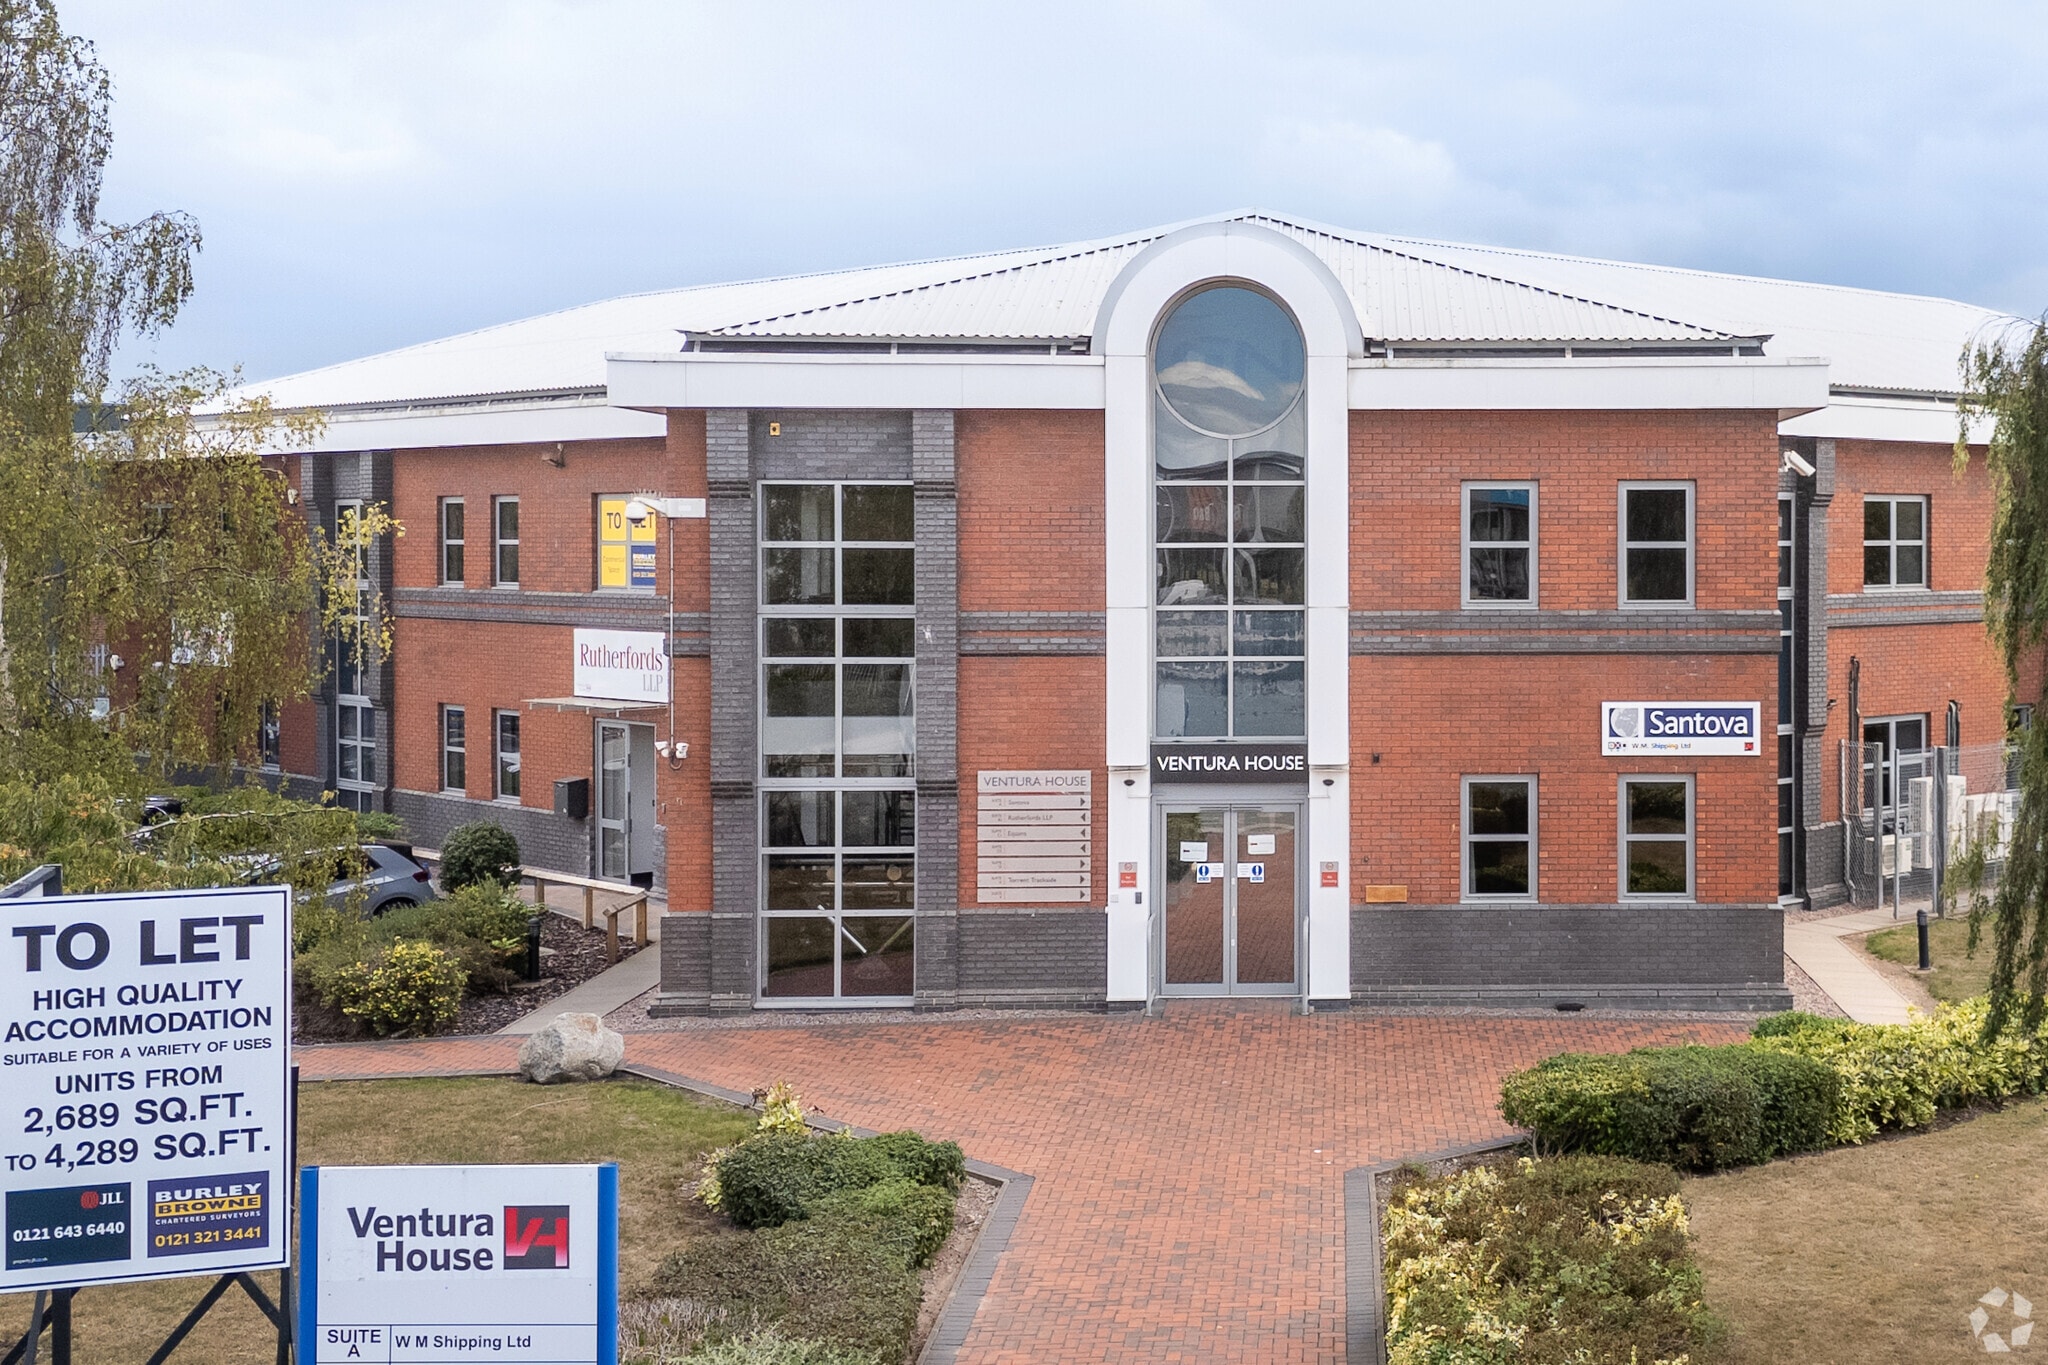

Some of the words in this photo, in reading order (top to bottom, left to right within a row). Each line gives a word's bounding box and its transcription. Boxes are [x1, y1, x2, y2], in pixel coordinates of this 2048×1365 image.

[606, 512, 622, 528] TO
[580, 643, 663, 672] Rutherfords
[643, 674, 664, 692] LLP
[1649, 710, 1748, 735] Santova
[1156, 755, 1241, 771] VENTURA
[1244, 755, 1304, 771] HOUSE
[984, 776, 1042, 787] VENTURA
[1045, 776, 1087, 787] HOUSE
[12, 922, 111, 972] TO
[140, 914, 264, 966] LET
[33, 986, 106, 1011] HIGH
[117, 978, 244, 1006] QUALITY
[4, 1006, 272, 1043] ACCOMMODATION
[3, 1050, 78, 1066] SUITABLE
[82, 1048, 114, 1062] FOR
[120, 1047, 132, 1058] A
[138, 1042, 202, 1058] VARIETY
[206, 1040, 228, 1054] OF
[233, 1038, 272, 1052] USES
[55, 1070, 136, 1095] UNITS
[145, 1064, 223, 1090] FROM
[24, 1102, 120, 1136] 2,689
[134, 1092, 252, 1126] SQ.FT.
[4, 1154, 36, 1172] TO
[44, 1138, 138, 1173] 4,289
[154, 1127, 271, 1161] SQ.FT.
[99, 1191, 125, 1206] JLL
[155, 1182, 262, 1203] BURLEY
[158, 1196, 260, 1215] BROWNE
[155, 1215, 207, 1226] CHARTERED
[210, 1210, 262, 1222] SURVEYORS
[346, 1206, 494, 1238] Ventura
[12, 1228, 50, 1242] 0121
[54, 1224, 82, 1239] 643
[86, 1221, 126, 1237] 6440
[154, 1232, 190, 1248] 0121
[194, 1230, 220, 1244] 321
[224, 1226, 262, 1242] 3441
[376, 1240, 494, 1272] House
[327, 1329, 382, 1344] SUITE
[395, 1336, 411, 1348] W
[416, 1336, 428, 1348] M
[433, 1336, 502, 1350] Shipping
[507, 1336, 531, 1348] Ltd
[347, 1344, 360, 1358] A
